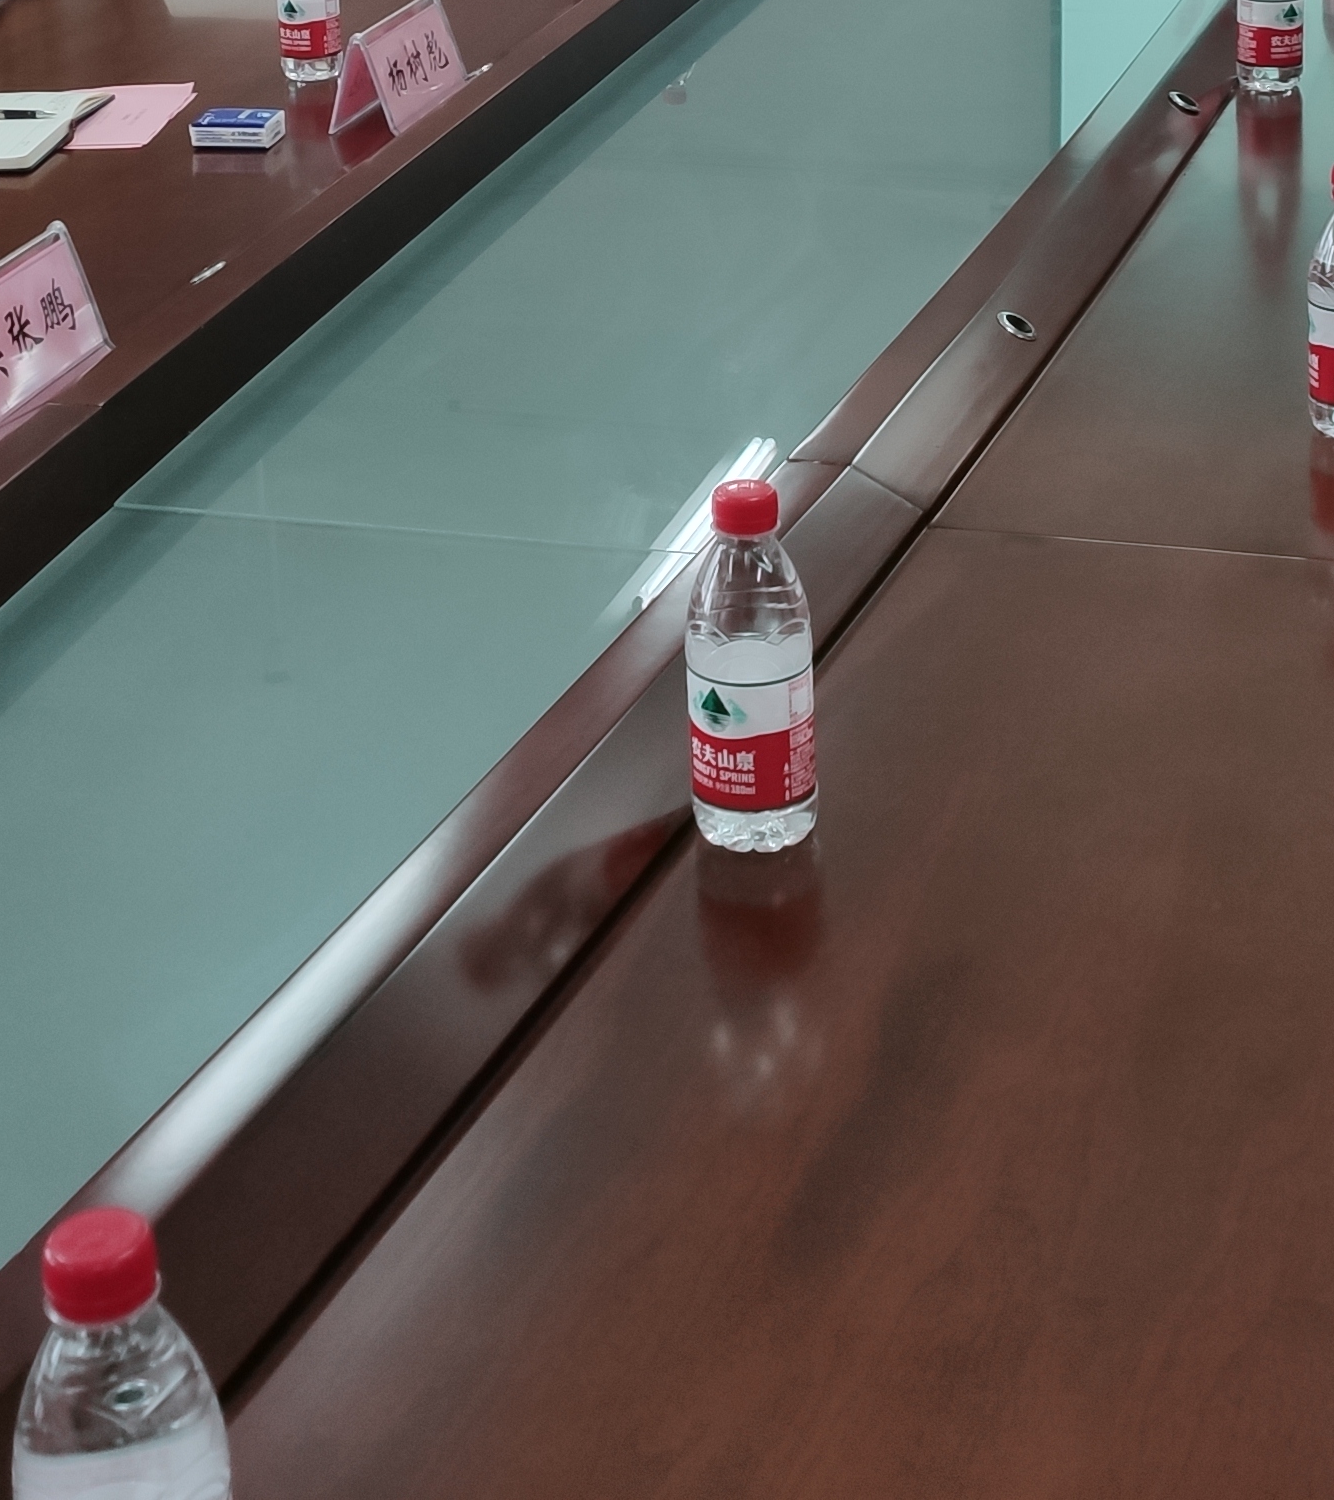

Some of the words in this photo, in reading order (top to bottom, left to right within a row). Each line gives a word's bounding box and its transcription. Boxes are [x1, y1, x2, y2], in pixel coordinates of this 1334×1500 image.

[691, 736, 755, 772] 农夫山泉
[719, 769, 756, 784] SPRING
